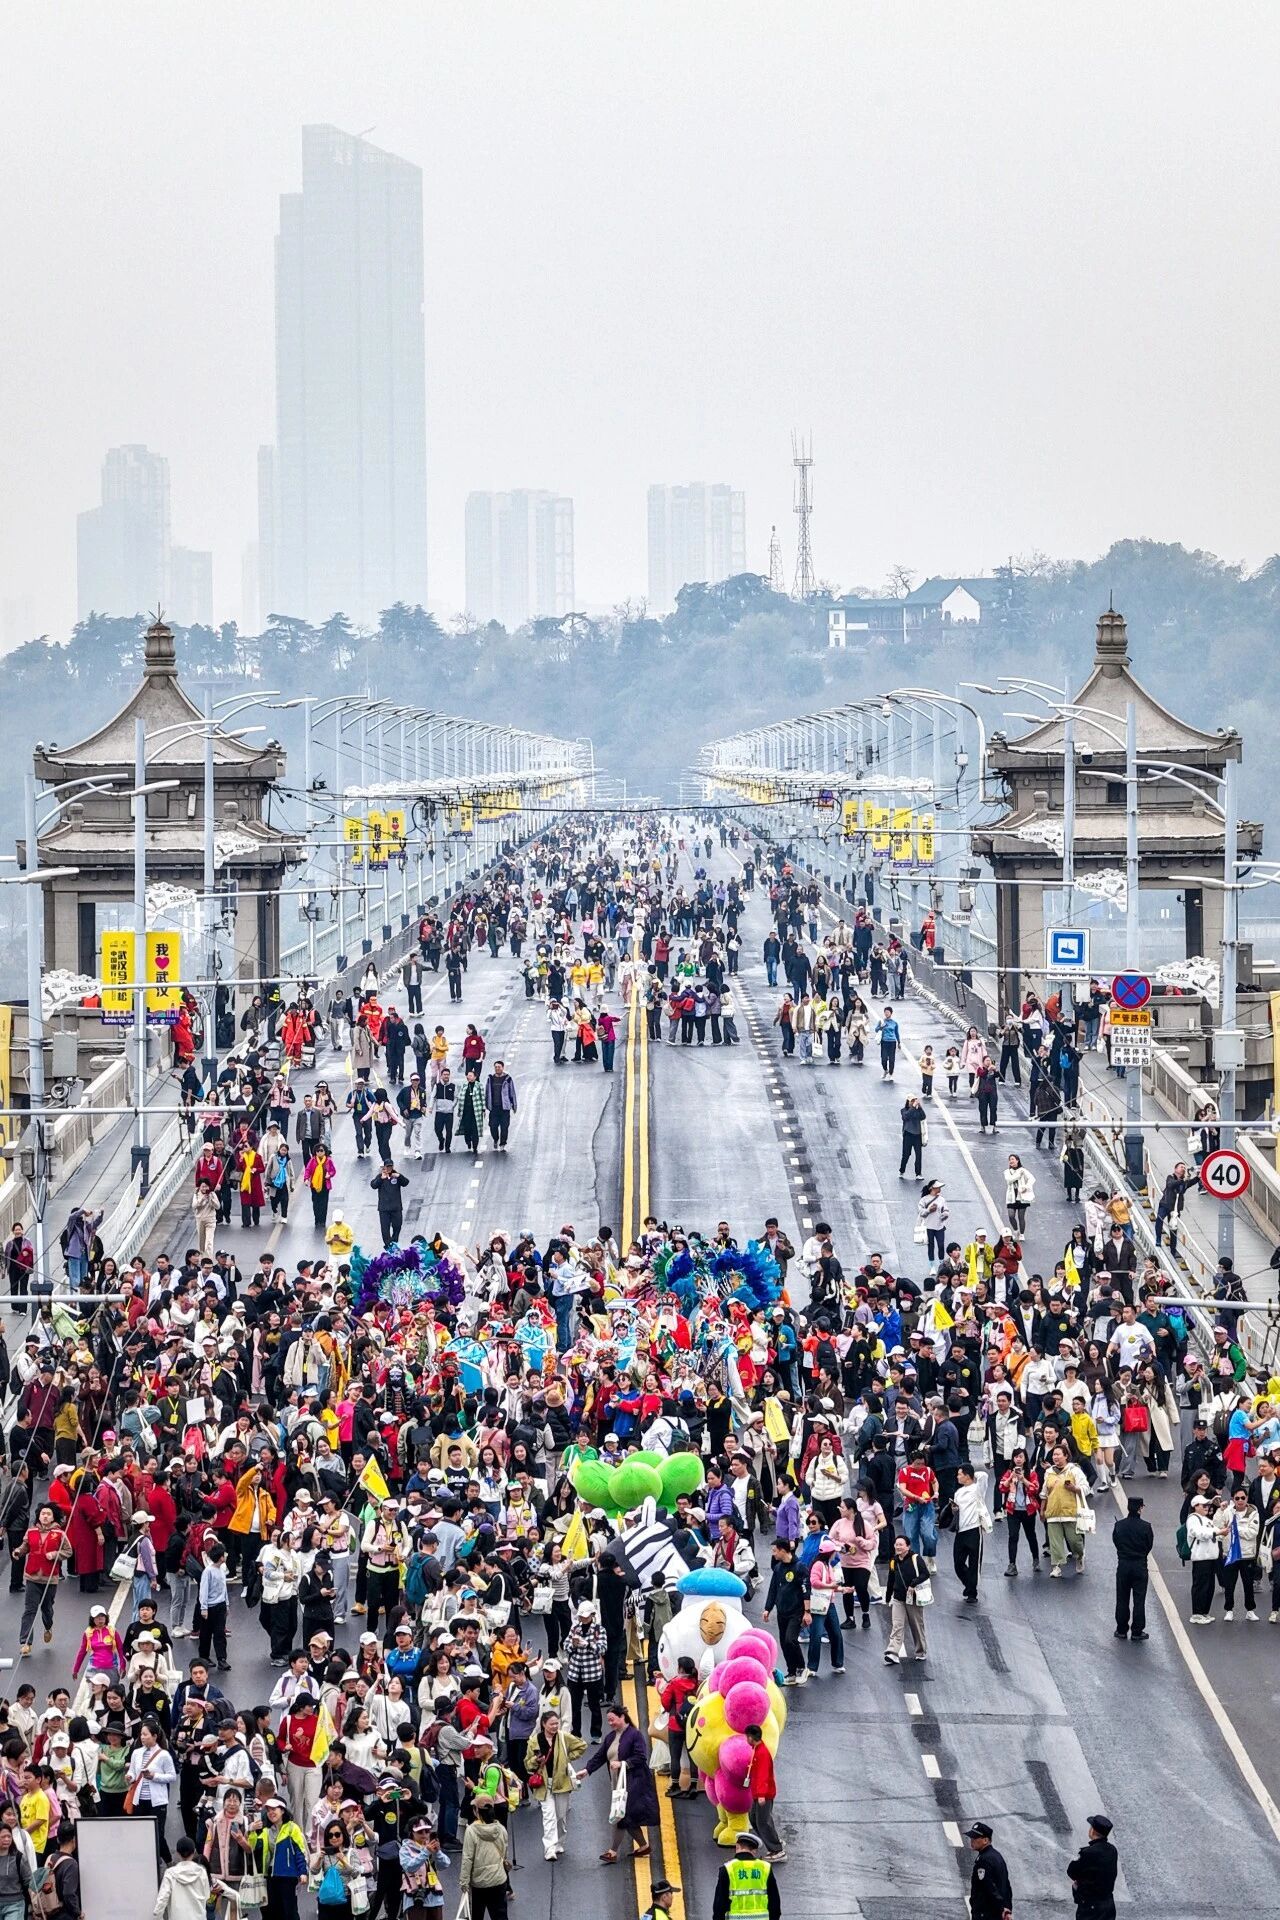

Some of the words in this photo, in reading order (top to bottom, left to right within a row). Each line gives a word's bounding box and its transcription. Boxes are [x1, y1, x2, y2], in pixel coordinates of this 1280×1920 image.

[156, 943, 169, 956] 我
[156, 971, 169, 997] 武汉
[1112, 1013, 1148, 1022] 严管路段
[1114, 1047, 1149, 1056] 严禁停车
[1114, 1056, 1149, 1065] 违停即拍
[1211, 1163, 1241, 1186] 40
[738, 1868, 761, 1880] 执勤
